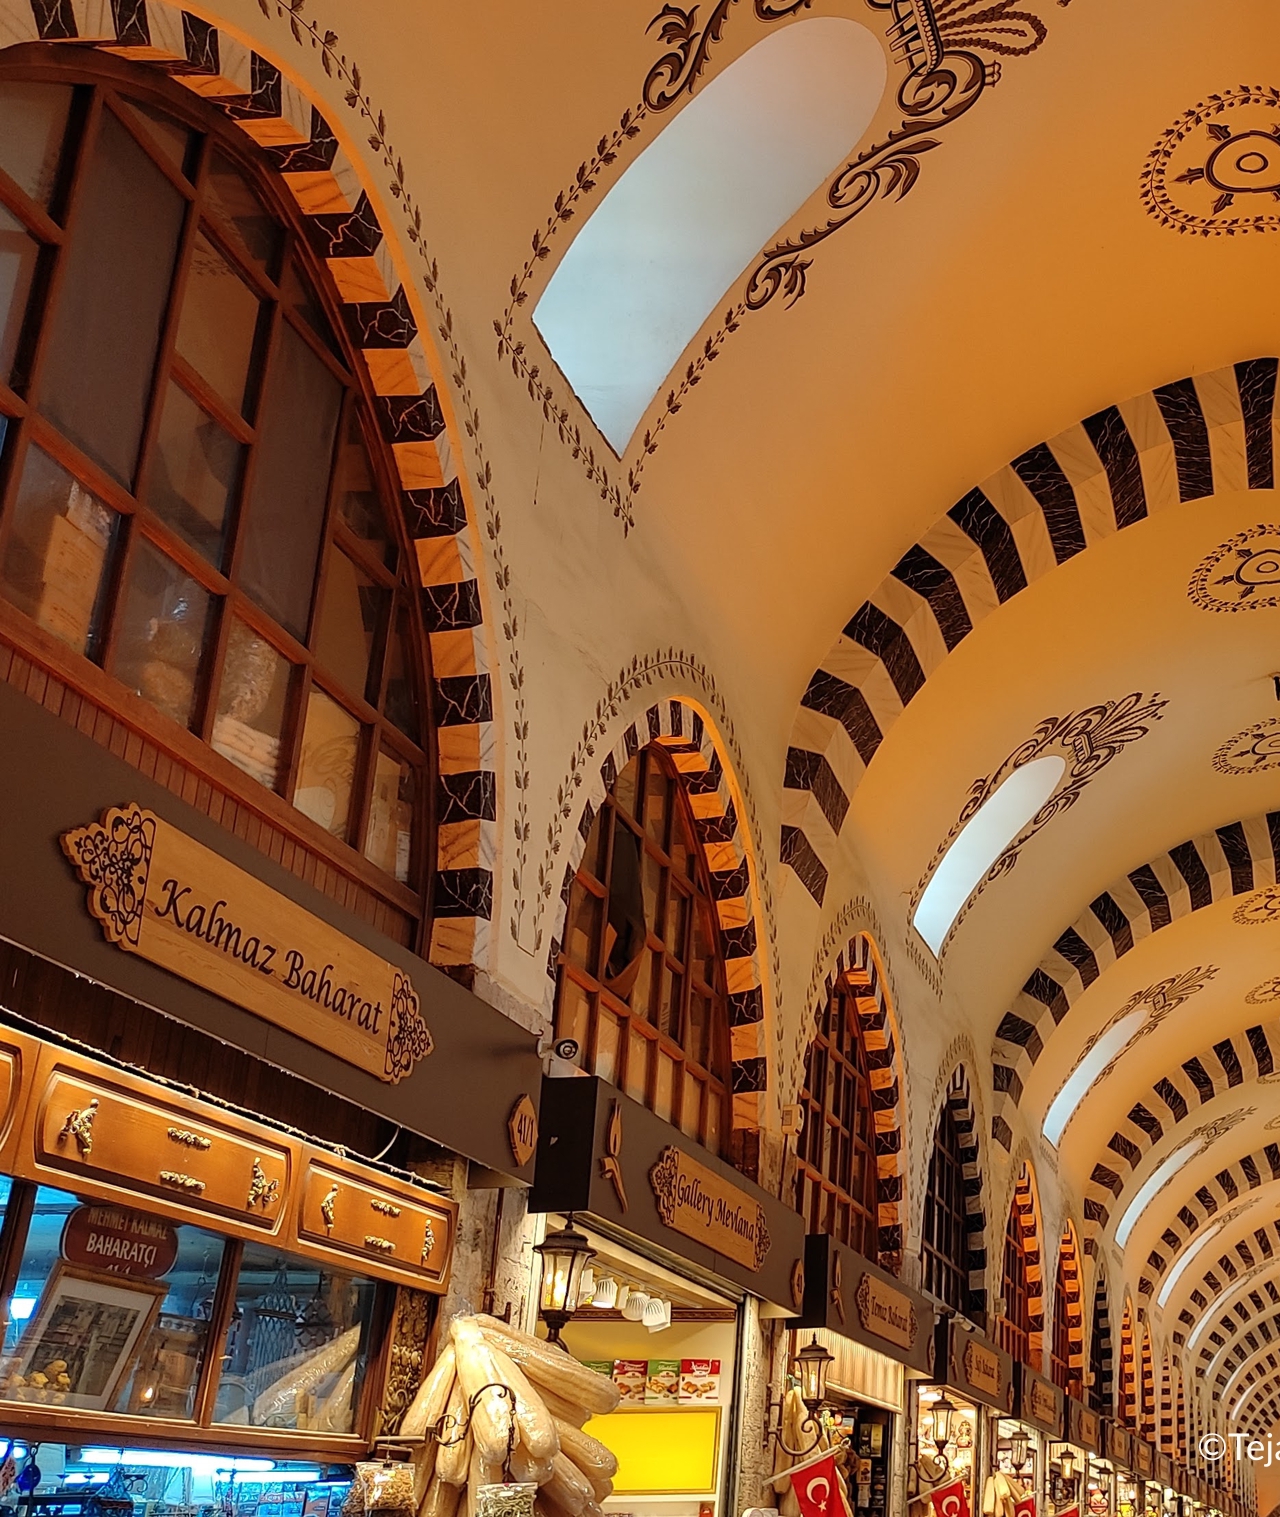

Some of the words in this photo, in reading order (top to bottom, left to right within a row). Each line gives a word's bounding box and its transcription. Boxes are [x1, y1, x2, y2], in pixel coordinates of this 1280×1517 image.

[154, 879, 277, 975] Kalmaz
[282, 949, 385, 1035] Baharat
[517, 1114, 534, 1147] 41/1
[88, 1207, 129, 1231] MEHMET
[677, 1174, 714, 1227] Gallery
[715, 1198, 755, 1243] Mevlana
[86, 1232, 157, 1268] BAHARATÇI
